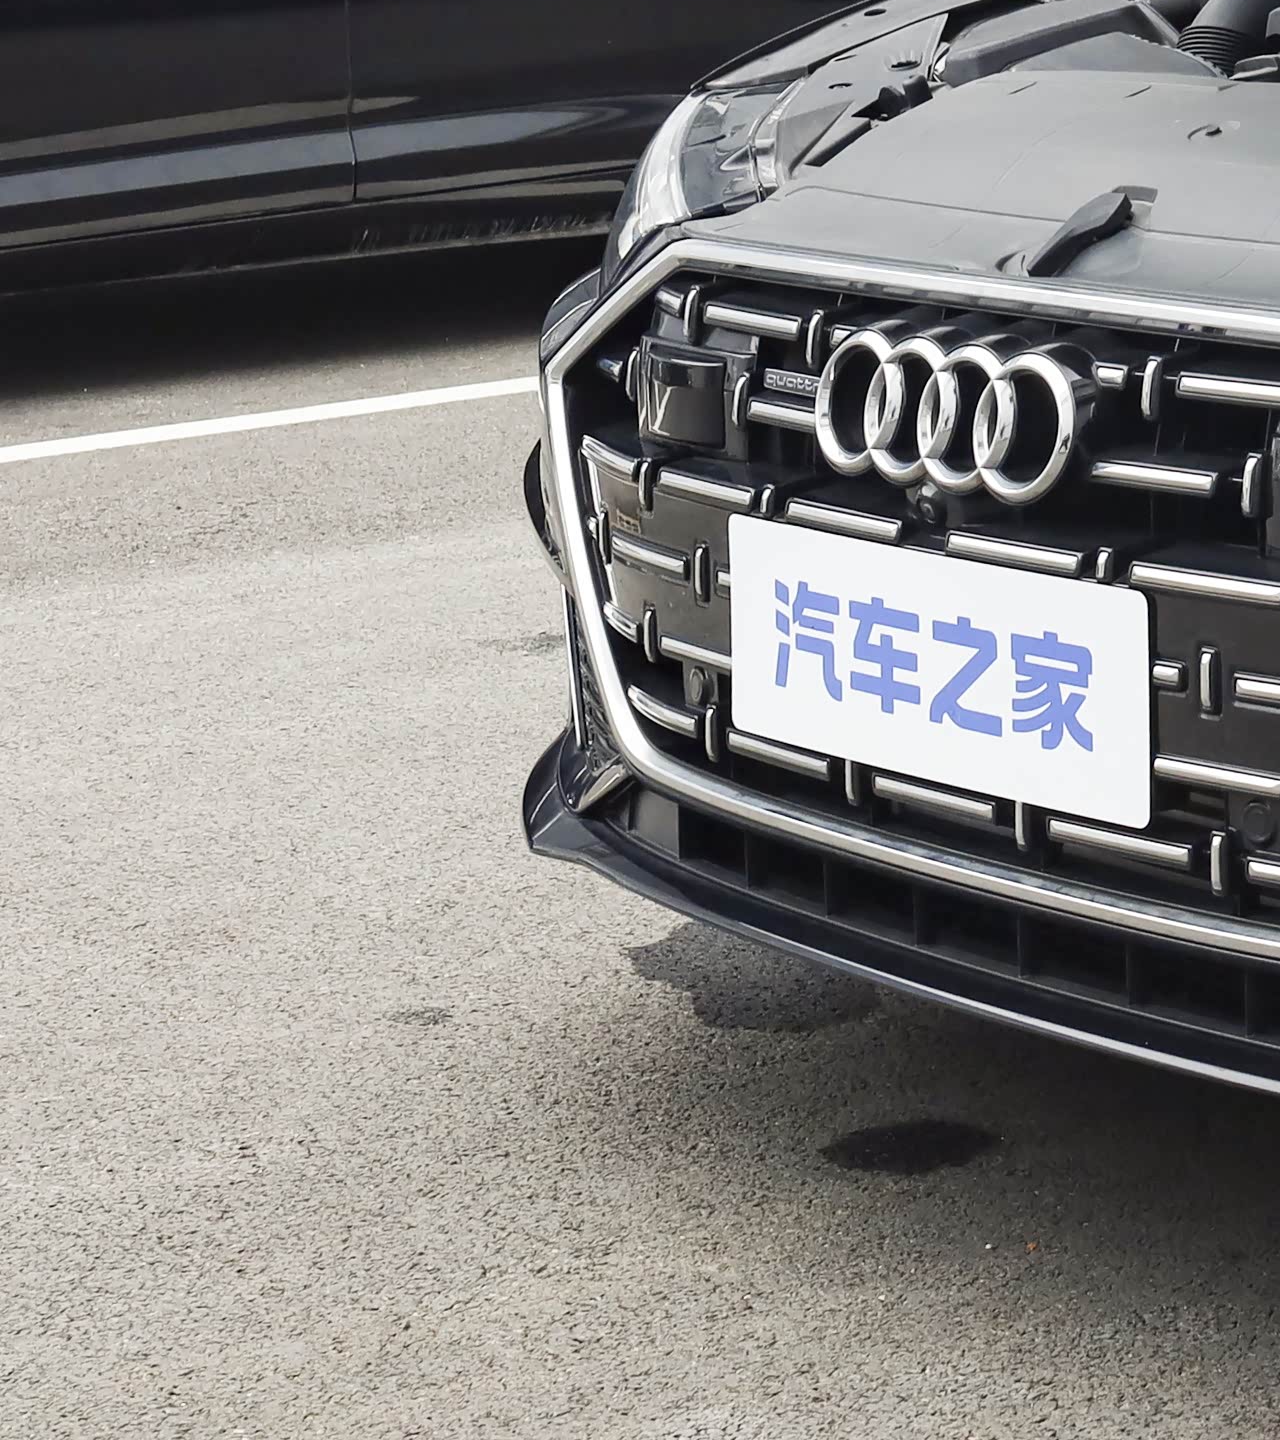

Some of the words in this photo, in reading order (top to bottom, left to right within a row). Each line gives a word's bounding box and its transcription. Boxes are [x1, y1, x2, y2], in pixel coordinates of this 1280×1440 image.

[766, 373, 819, 392] quattr
[775, 580, 1093, 751] 汽车之家
